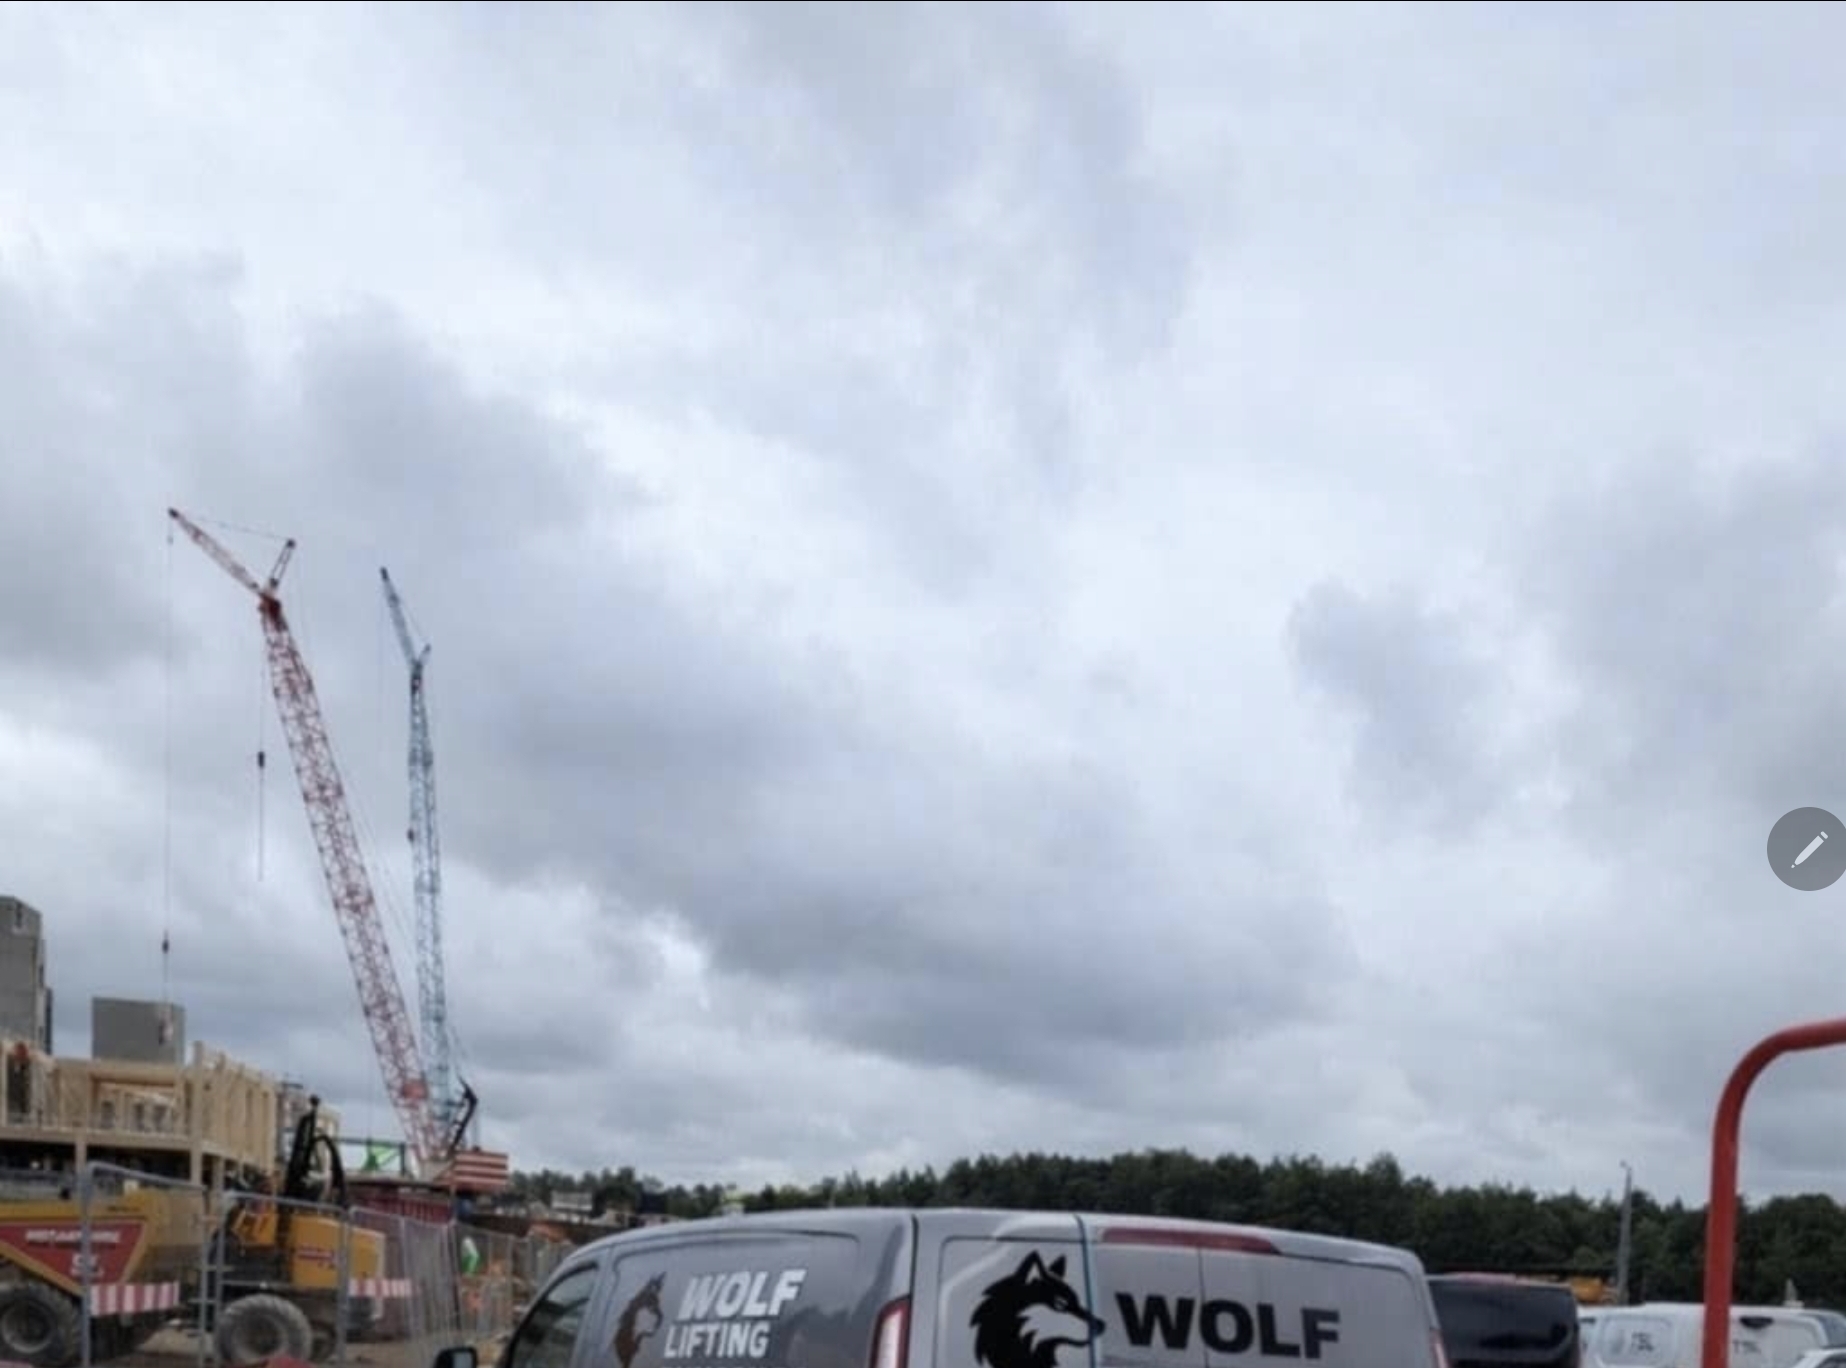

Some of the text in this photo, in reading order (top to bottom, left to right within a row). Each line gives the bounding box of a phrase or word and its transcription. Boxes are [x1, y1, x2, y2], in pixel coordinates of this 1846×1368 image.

[677, 1269, 807, 1321] WOLF
[664, 1321, 770, 1358] LIFTING
[1115, 1292, 1340, 1360] WOLF
